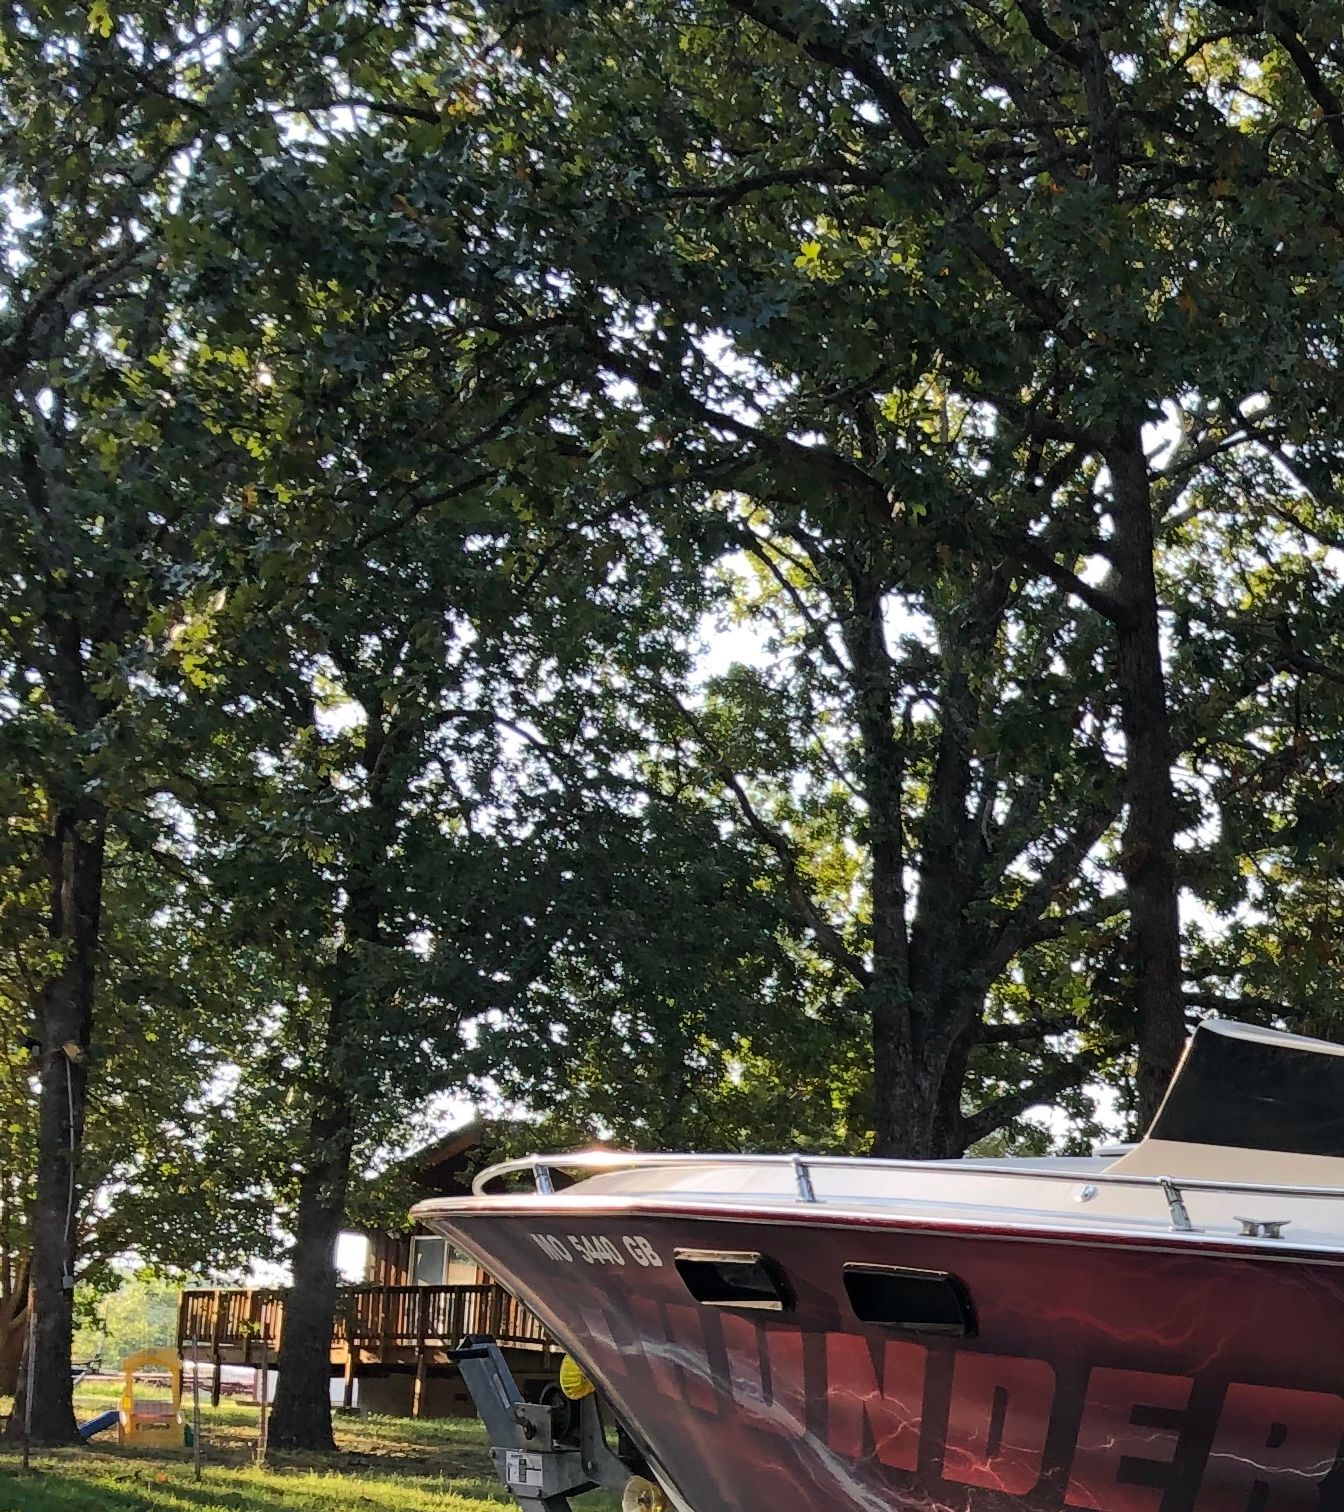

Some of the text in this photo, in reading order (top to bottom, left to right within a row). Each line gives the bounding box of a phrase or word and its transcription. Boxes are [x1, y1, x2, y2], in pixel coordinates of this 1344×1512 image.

[529, 1233, 663, 1267] MO 5440 GB
